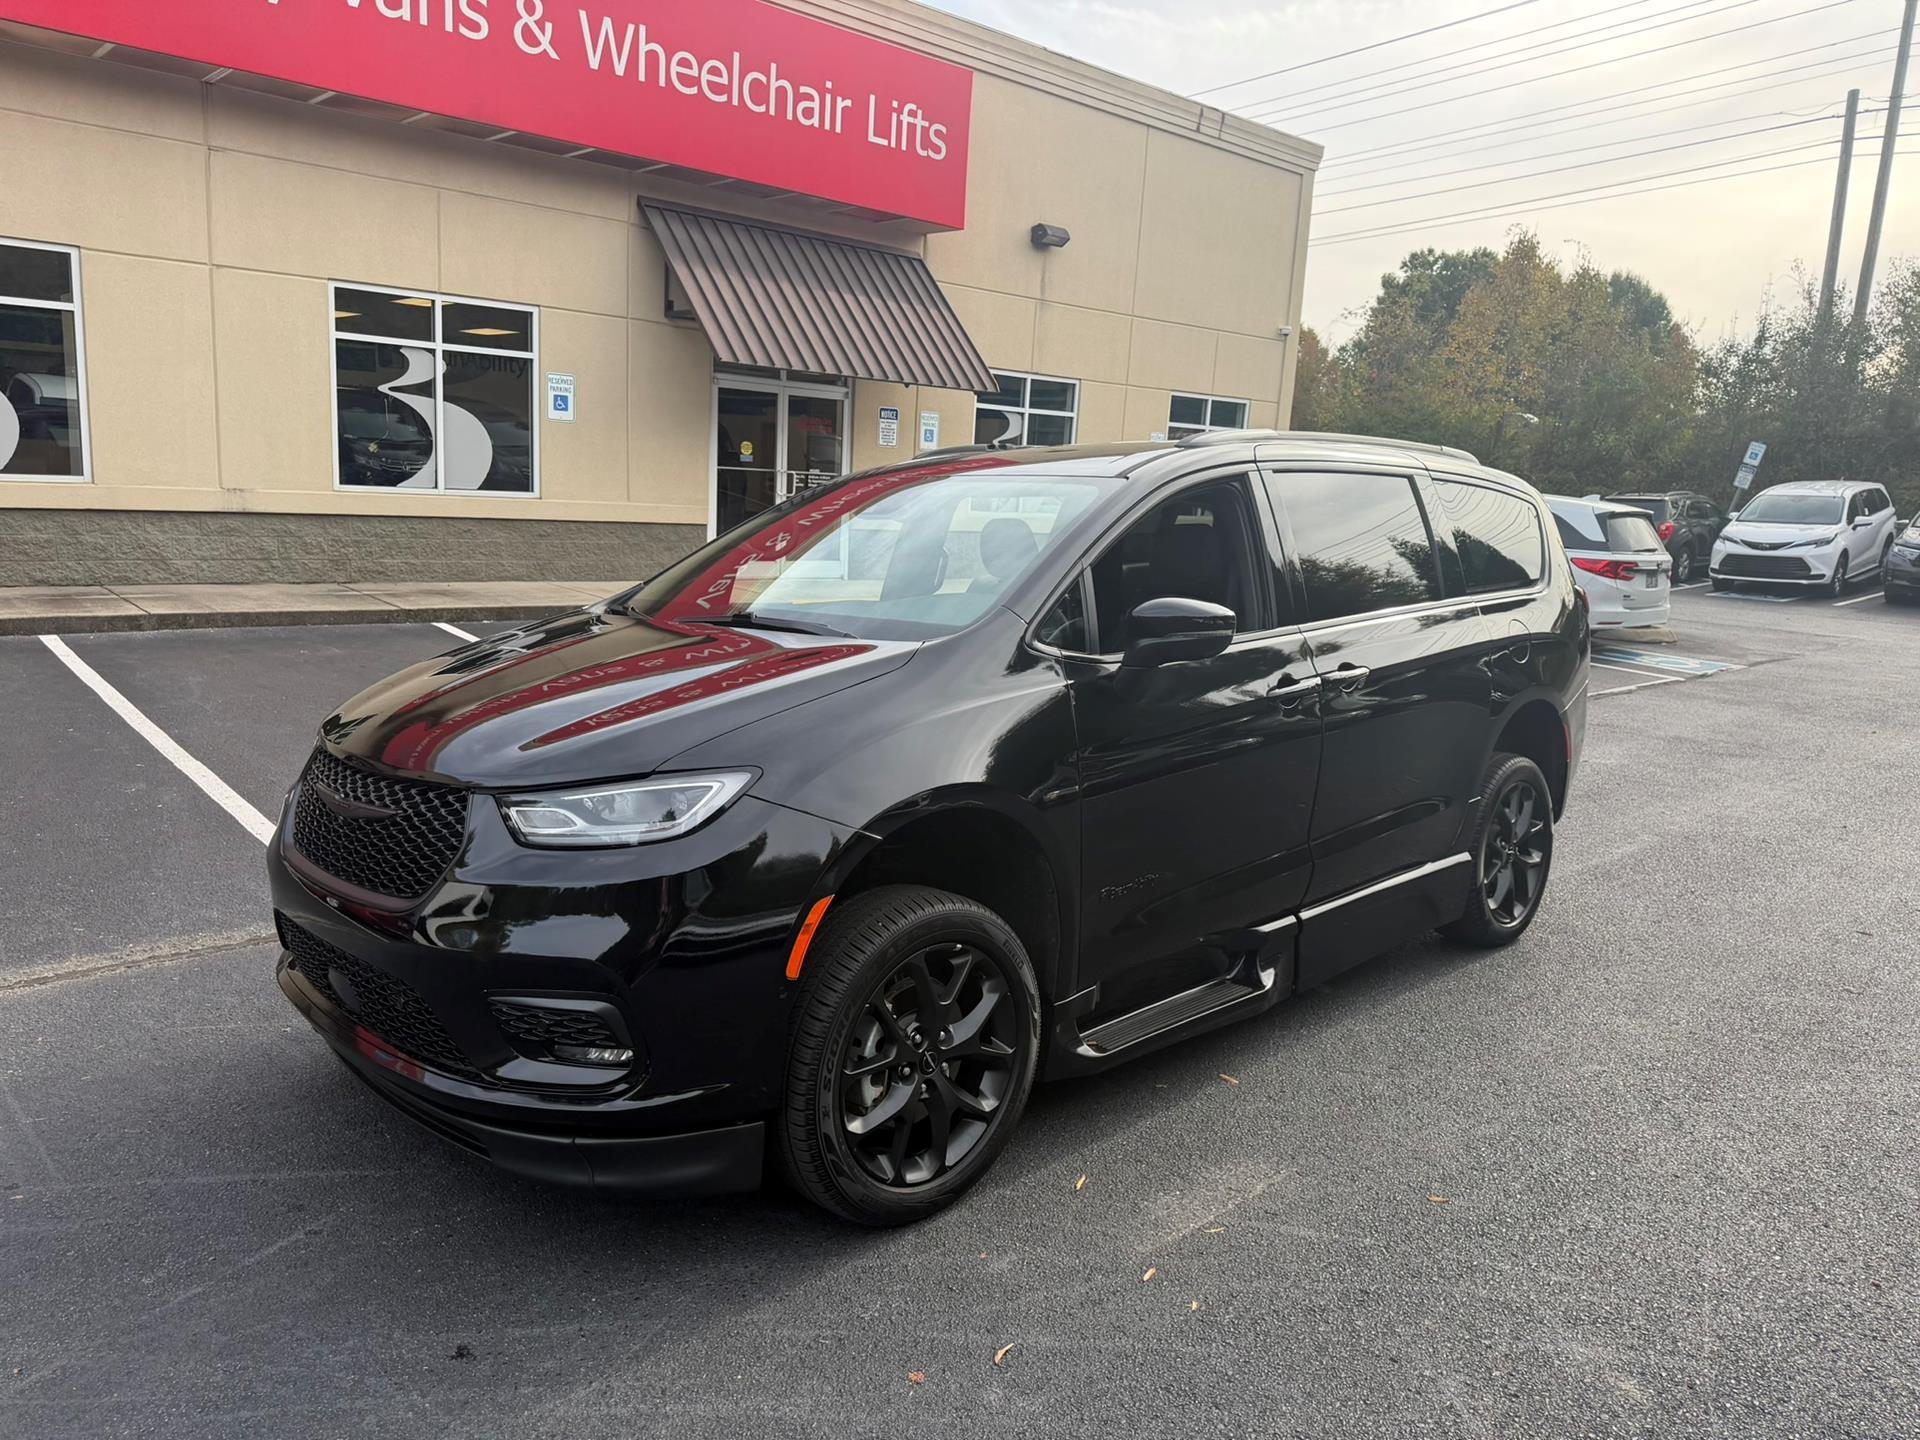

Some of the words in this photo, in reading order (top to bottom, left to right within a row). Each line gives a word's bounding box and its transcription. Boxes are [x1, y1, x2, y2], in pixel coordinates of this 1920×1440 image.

[346, 0, 490, 41] ans
[513, 0, 561, 60] &
[578, 8, 853, 134] Wheelchair
[867, 93, 948, 161] Lifts
[548, 376, 574, 386] RESERVED
[549, 385, 573, 394] PARKING
[880, 410, 897, 420] NOTICE
